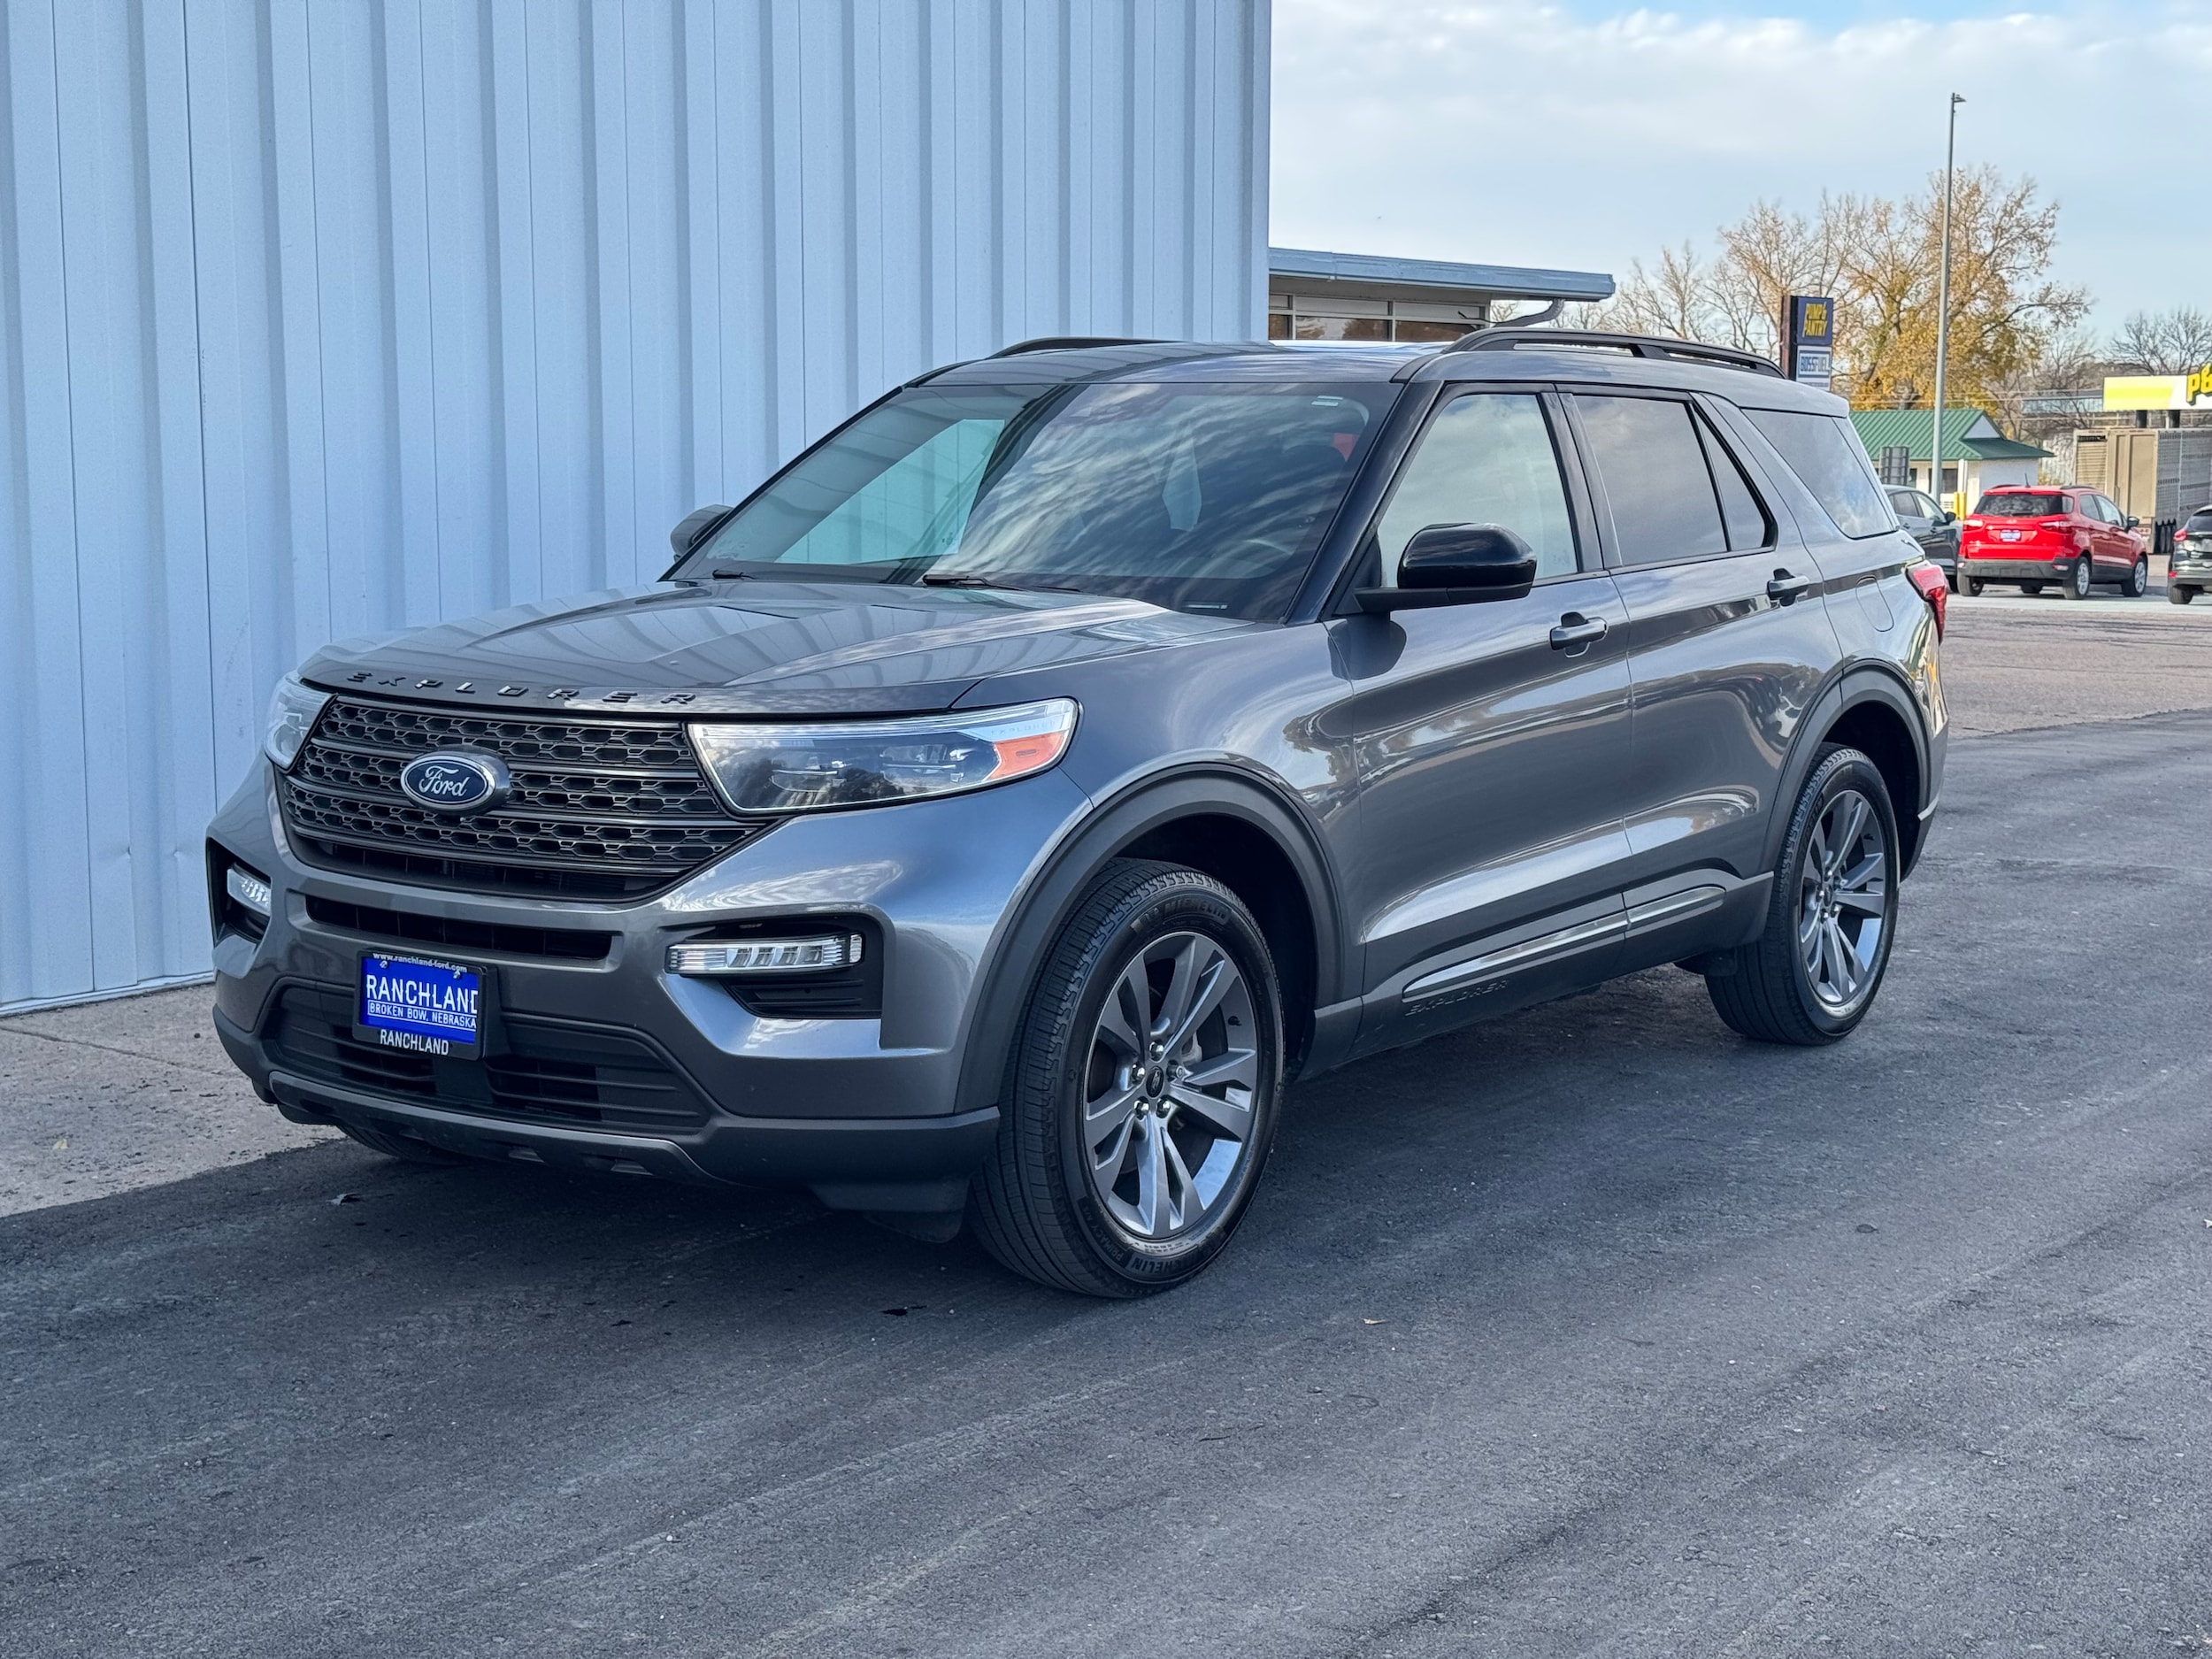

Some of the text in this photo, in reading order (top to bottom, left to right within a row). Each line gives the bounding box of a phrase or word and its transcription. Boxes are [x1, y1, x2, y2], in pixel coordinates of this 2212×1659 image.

[346, 671, 697, 705] EXPLORER
[419, 764, 471, 797] Ford
[370, 1002, 404, 1018] BROKEN
[432, 1011, 478, 1029] NEBRASKA
[380, 1029, 449, 1056] RANCHLAND
